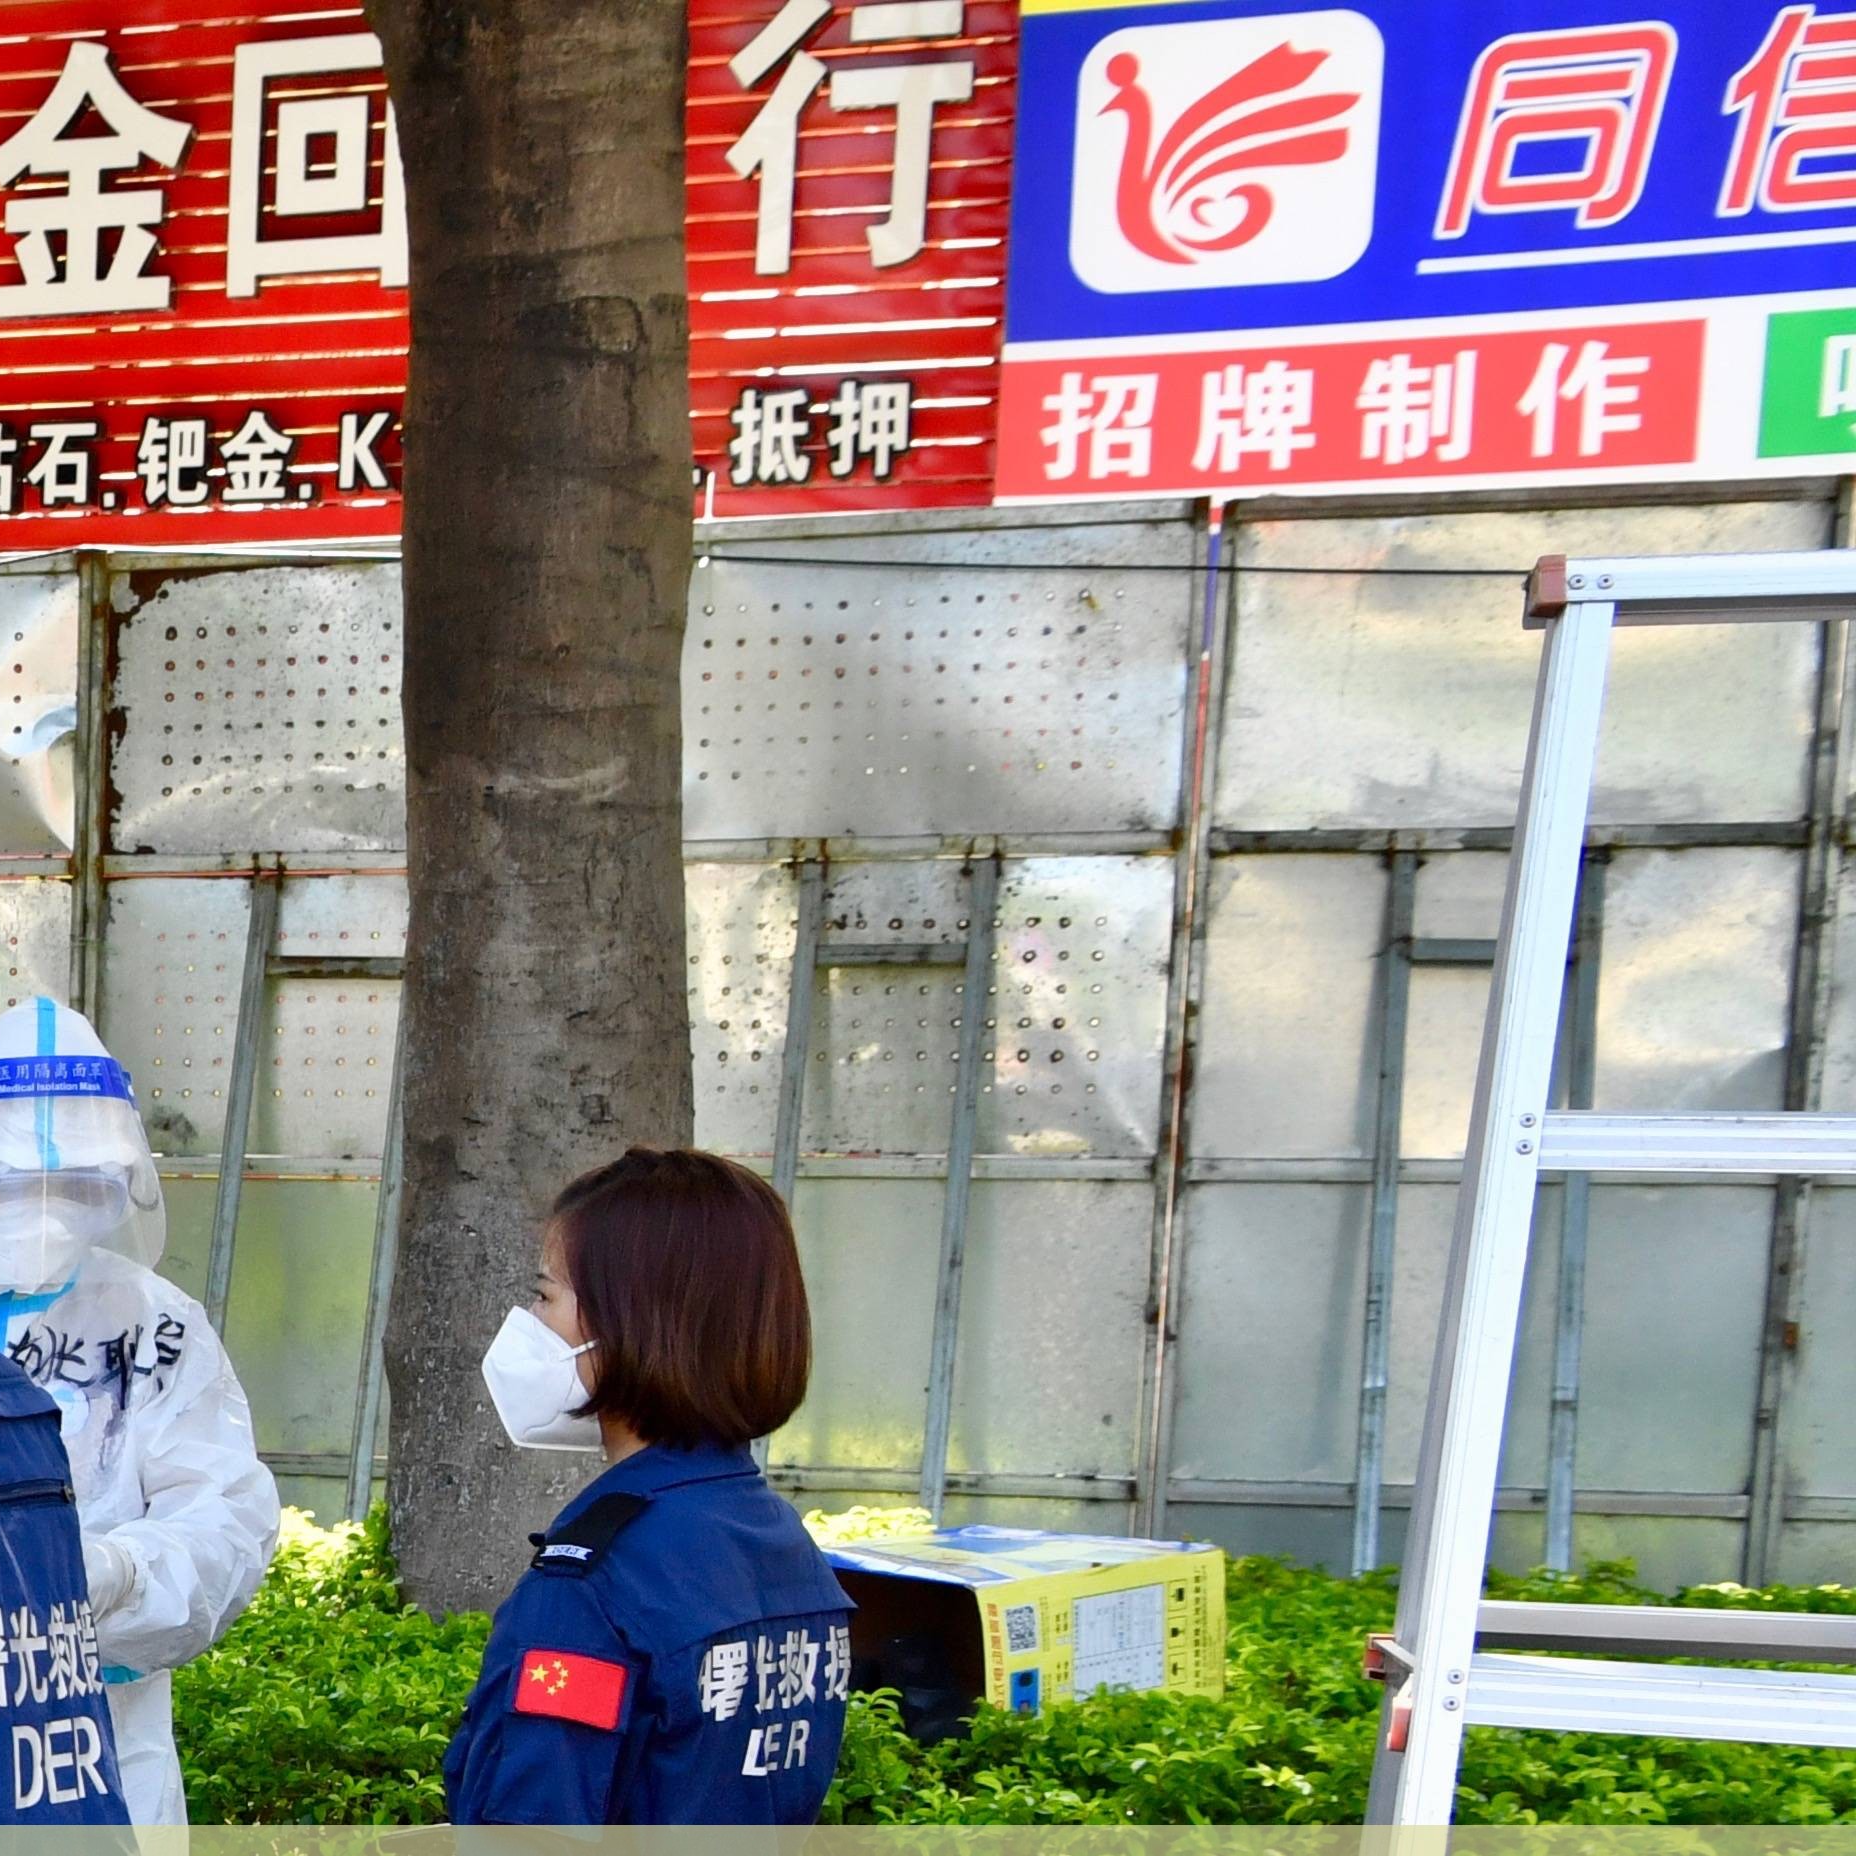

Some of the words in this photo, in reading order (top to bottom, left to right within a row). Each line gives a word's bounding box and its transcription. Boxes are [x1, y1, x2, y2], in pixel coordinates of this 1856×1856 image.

[1041, 342, 1652, 481] 招牌制作
[11, 1715, 109, 1810] DER
